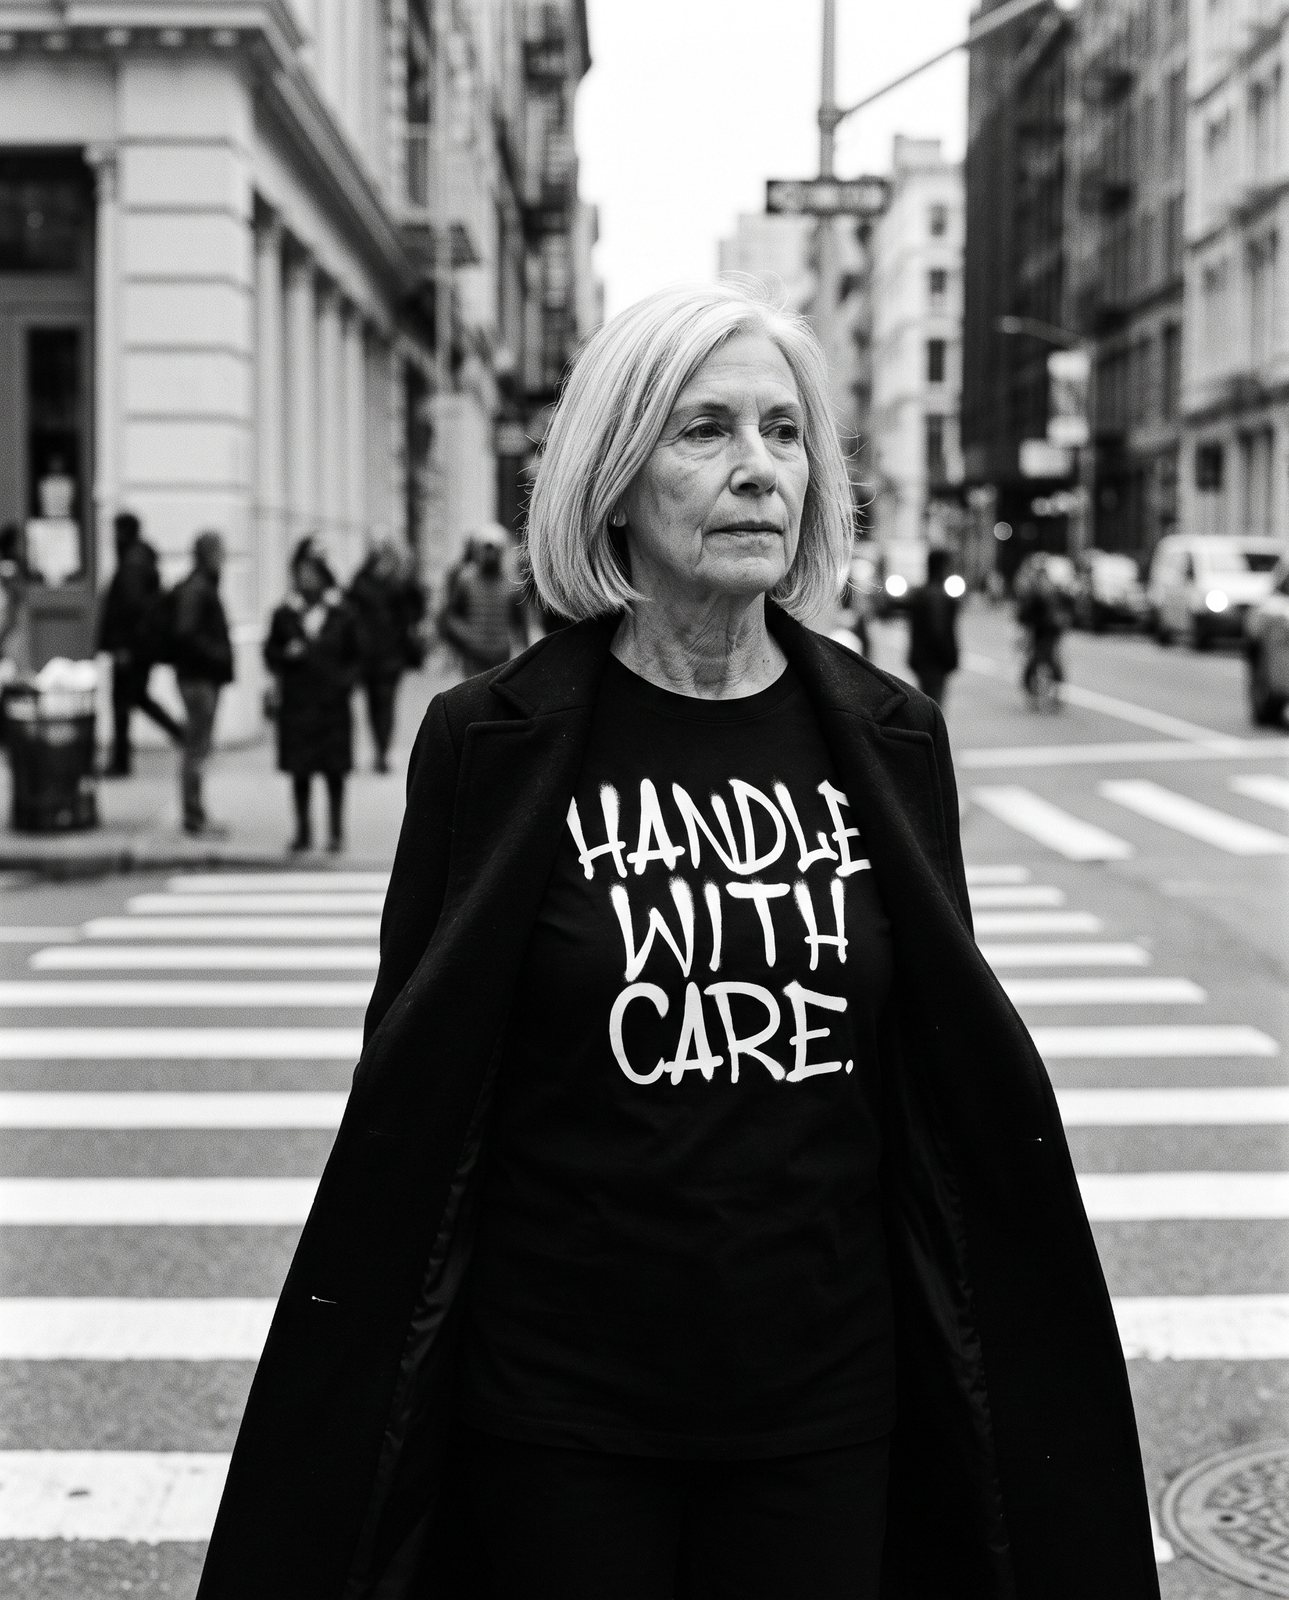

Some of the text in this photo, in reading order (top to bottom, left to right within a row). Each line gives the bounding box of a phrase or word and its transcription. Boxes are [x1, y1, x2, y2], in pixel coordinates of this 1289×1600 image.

[566, 778, 872, 880] HANDLE
[609, 876, 849, 982] WITH
[608, 980, 854, 1085] CARE.
